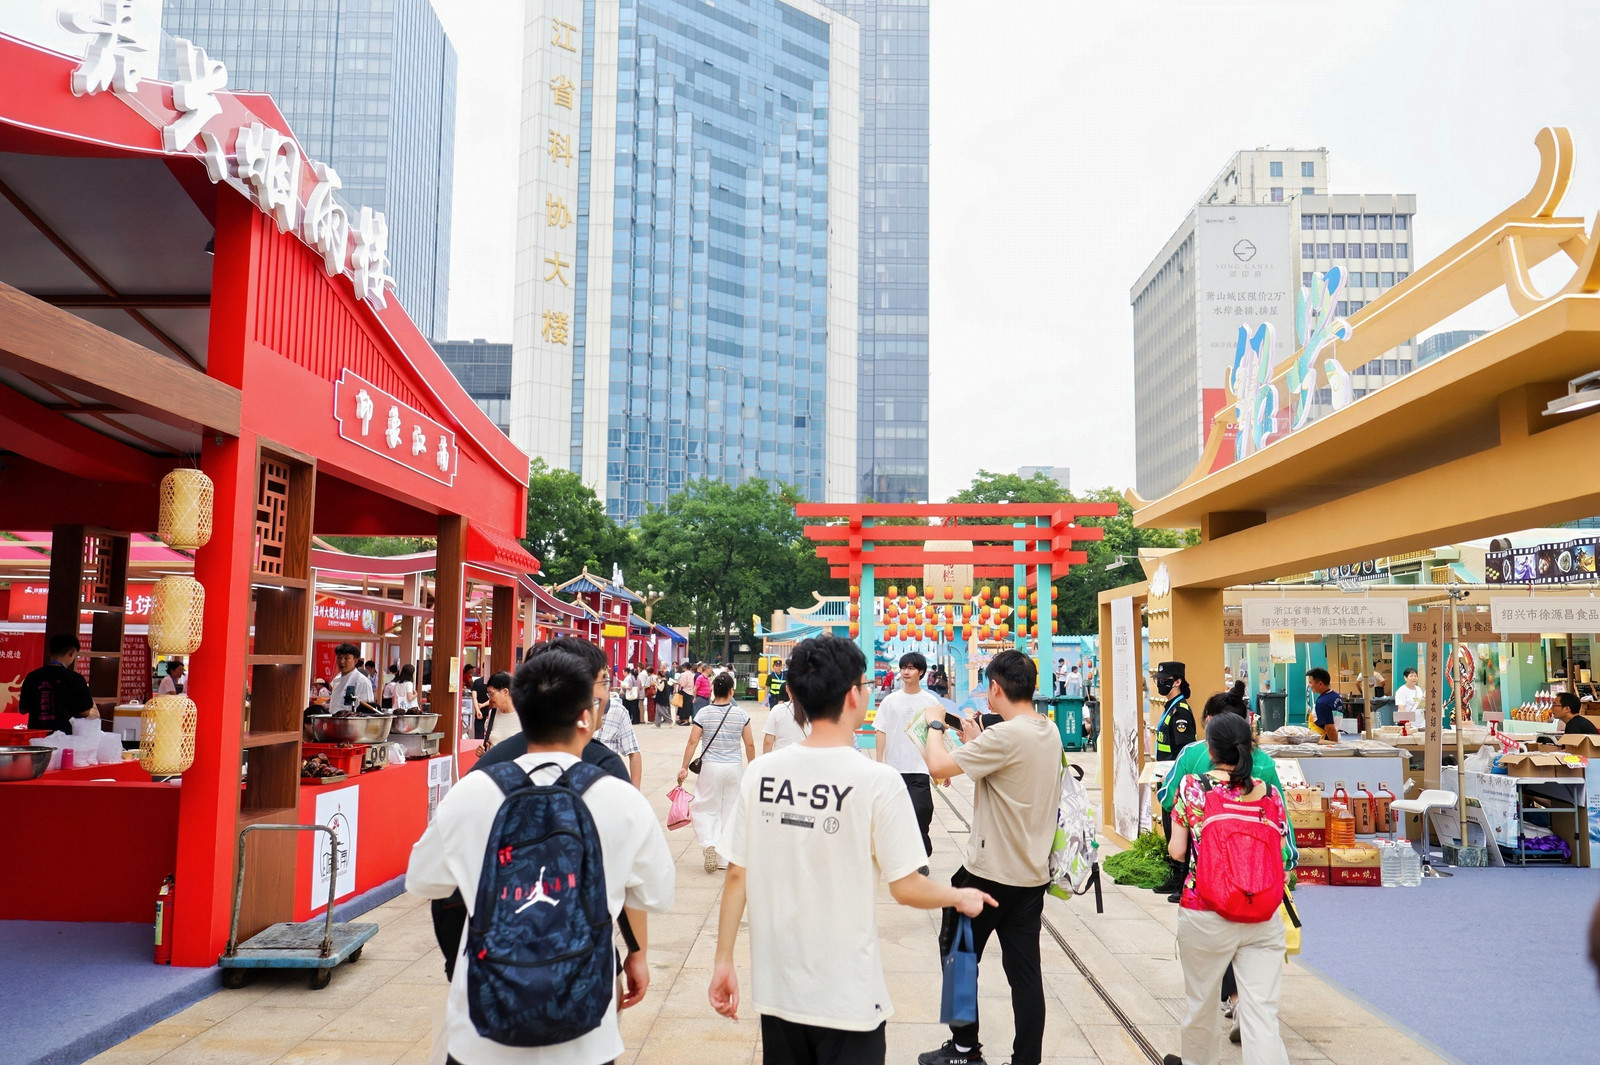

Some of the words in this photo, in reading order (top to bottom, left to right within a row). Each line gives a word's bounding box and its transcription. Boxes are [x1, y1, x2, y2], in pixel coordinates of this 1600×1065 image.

[541, 16, 577, 347] 江省科协大楼
[1501, 608, 1599, 620] 绍兴市徐源昌食品
[760, 777, 854, 812] EA-SY
